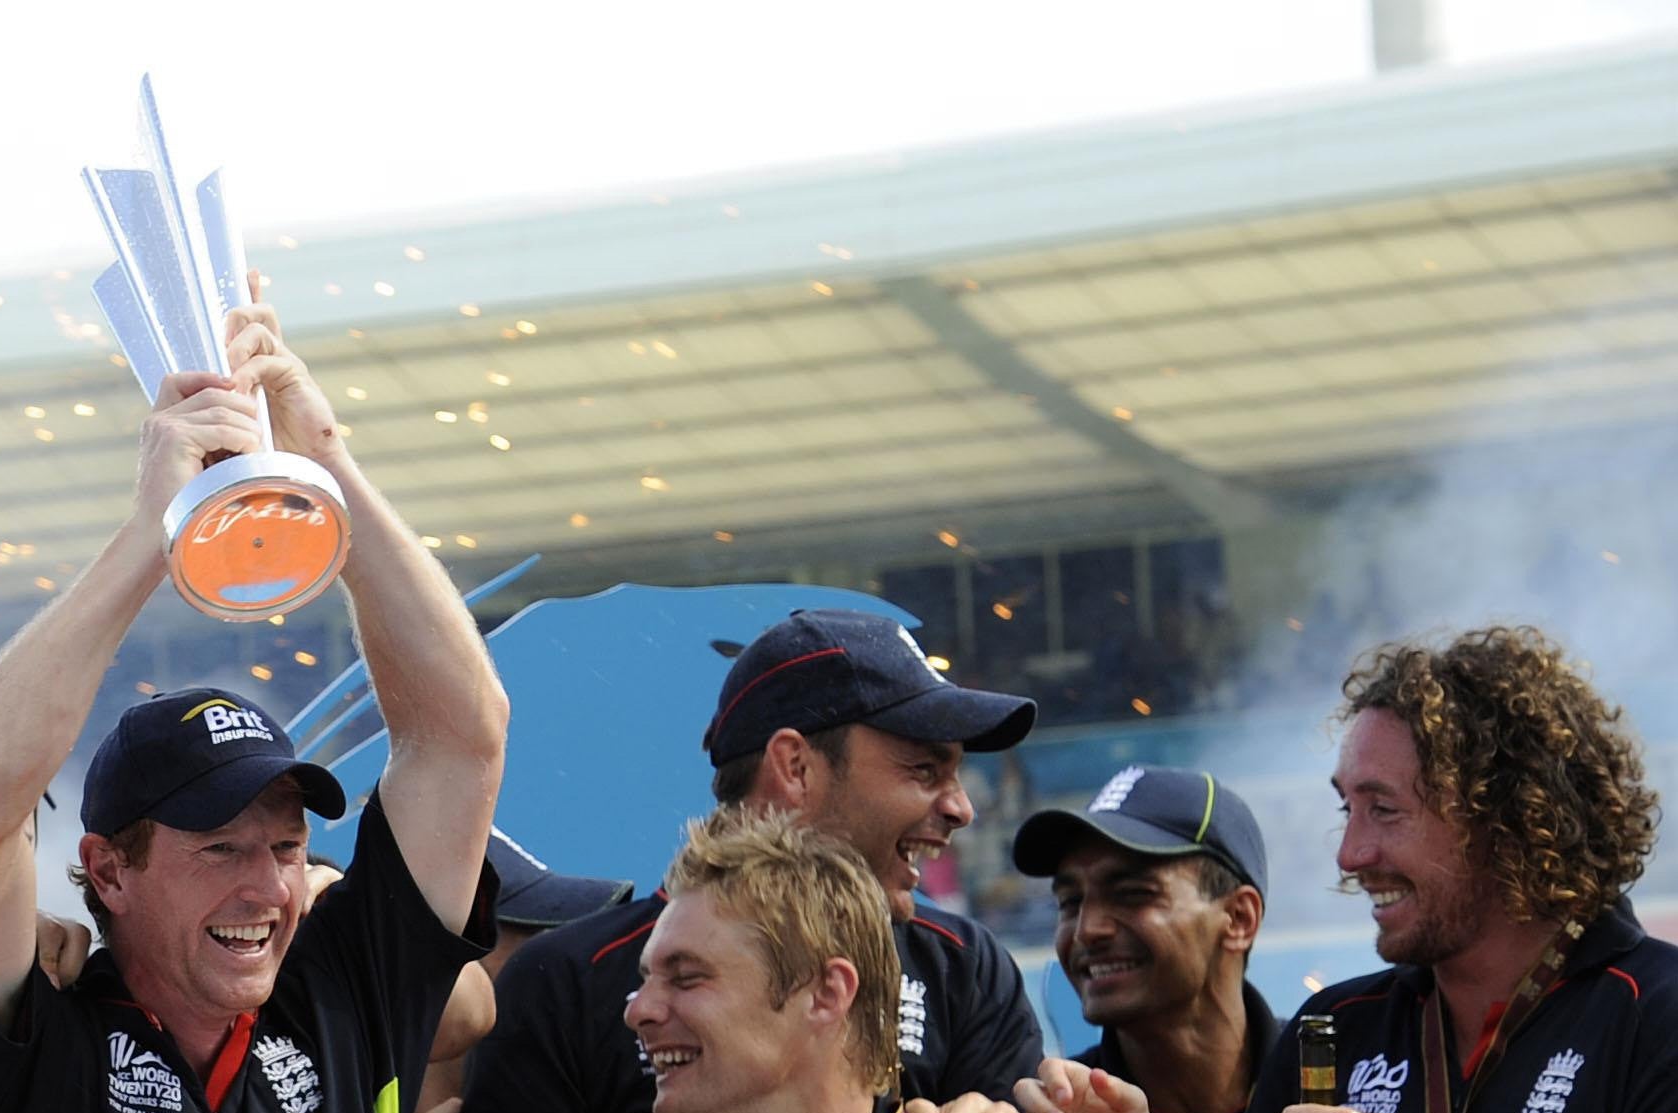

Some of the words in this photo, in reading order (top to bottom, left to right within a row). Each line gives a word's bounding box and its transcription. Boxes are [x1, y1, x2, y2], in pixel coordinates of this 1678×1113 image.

[203, 704, 270, 732] Brit
[210, 728, 274, 745] Insurance
[107, 1073, 182, 1102] TWENTY20
[131, 1066, 181, 1089] WORLD
